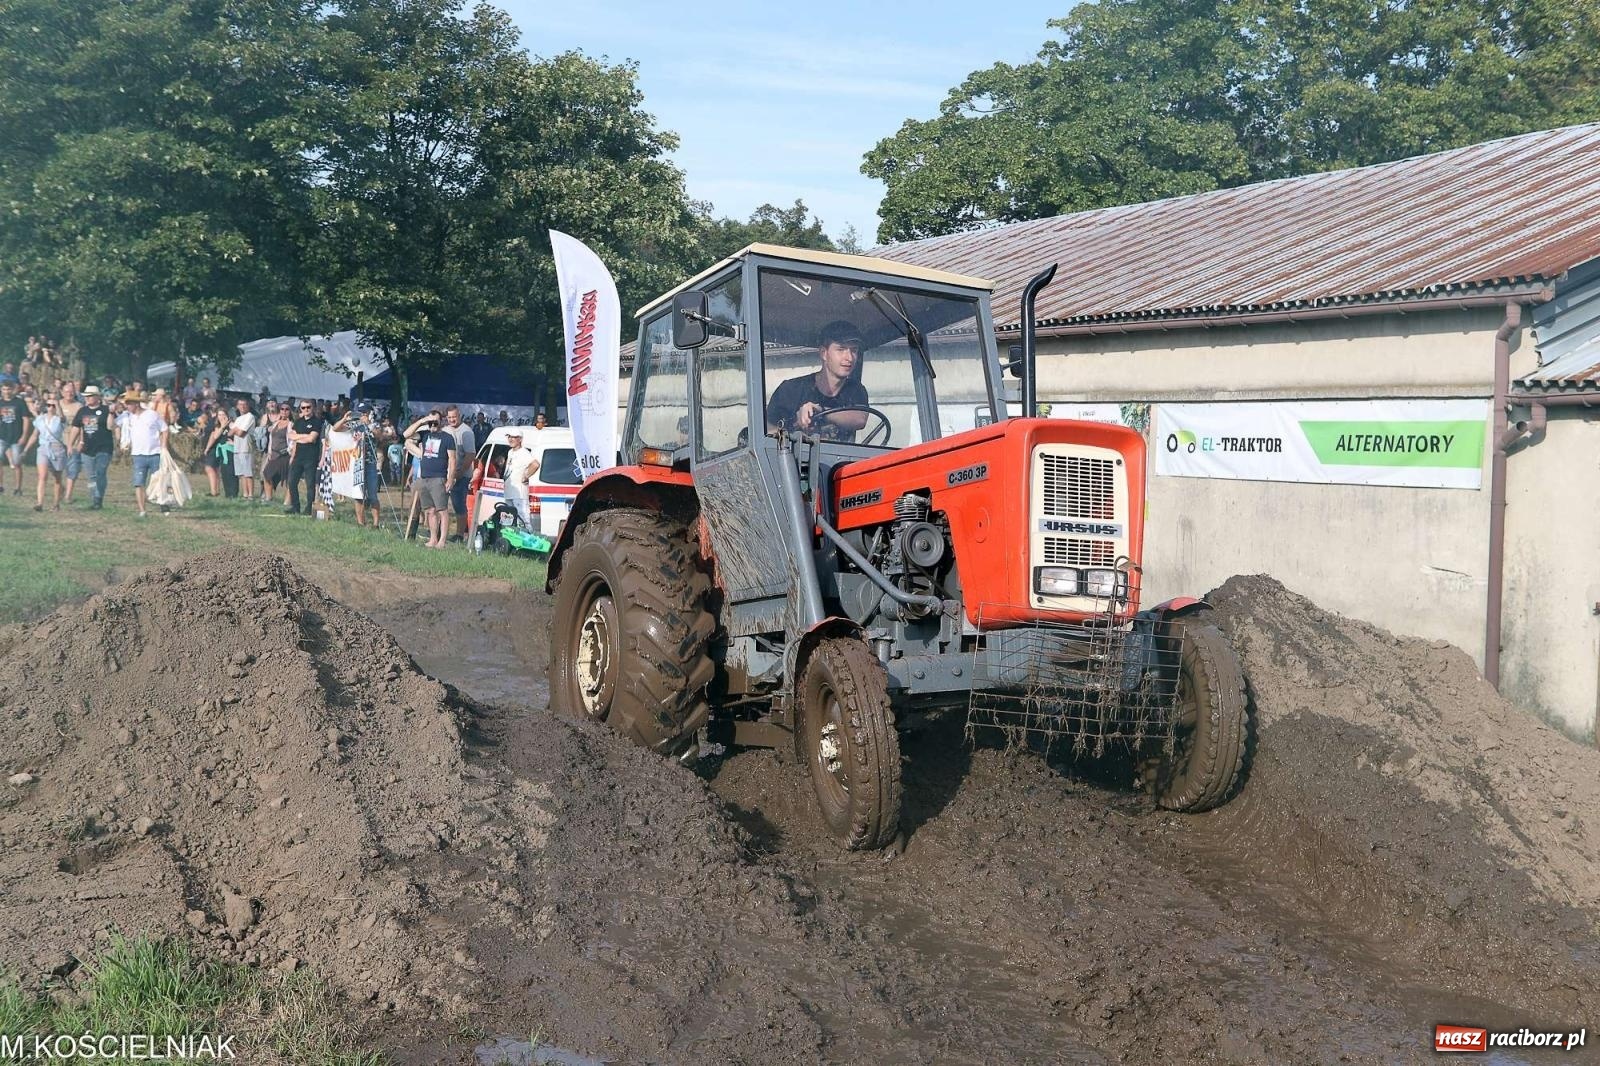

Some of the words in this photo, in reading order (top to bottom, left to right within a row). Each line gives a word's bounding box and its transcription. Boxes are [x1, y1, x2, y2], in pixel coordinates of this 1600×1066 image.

[1201, 437, 1282, 453] EL-TRAKTOR
[1335, 434, 1455, 453] ALTERNATORY
[948, 470, 973, 484] C-360
[976, 465, 987, 478] 3P
[840, 490, 882, 508] URSUS
[1044, 521, 1118, 535] URSUS
